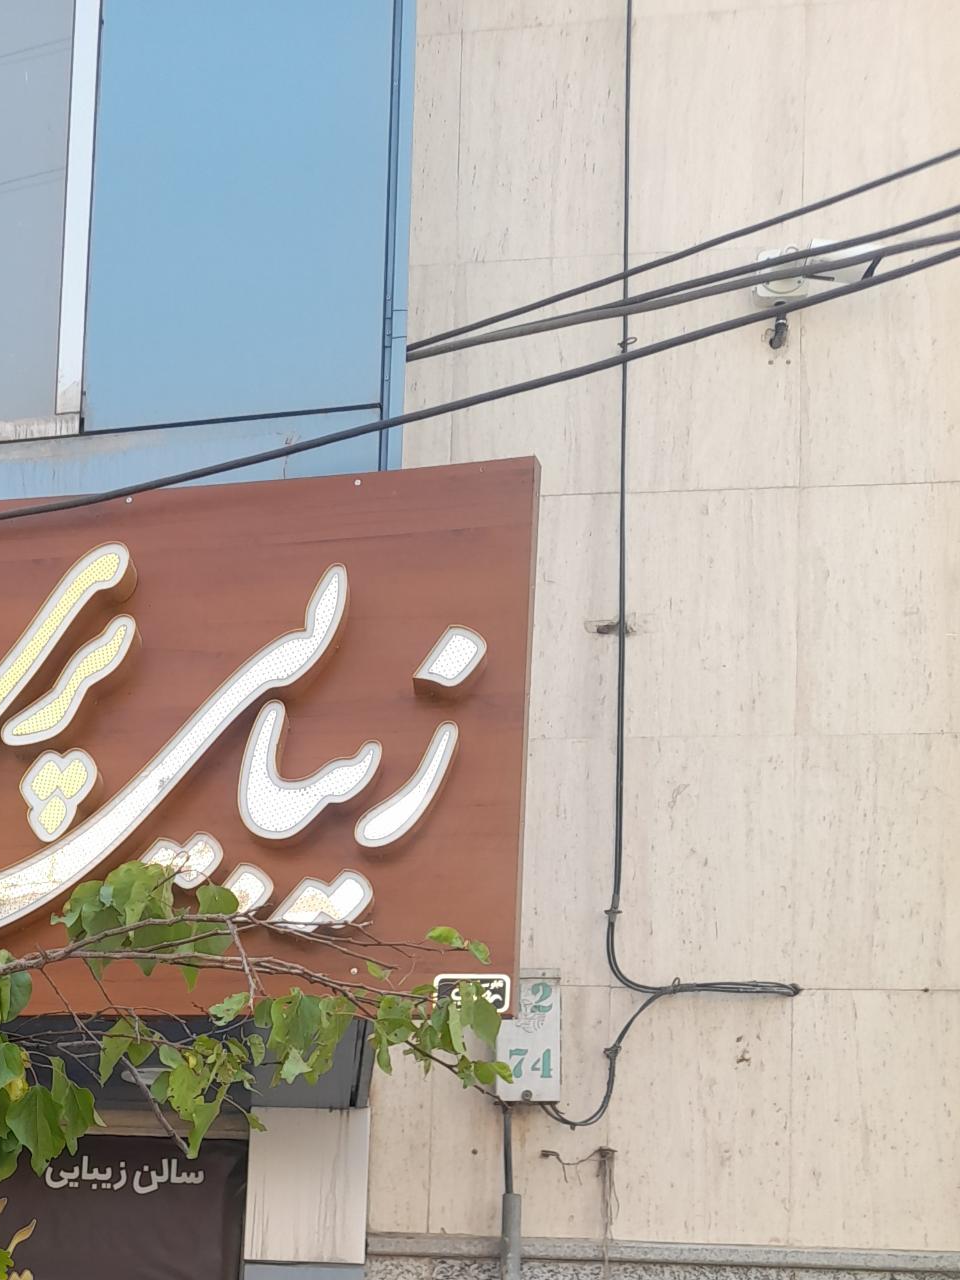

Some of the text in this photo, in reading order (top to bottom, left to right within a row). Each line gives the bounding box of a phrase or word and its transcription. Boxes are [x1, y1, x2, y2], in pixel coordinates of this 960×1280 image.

[530, 982, 554, 1013] 2
[509, 1048, 554, 1079] 74
[44, 1155, 205, 1194] سالن زیبایی
